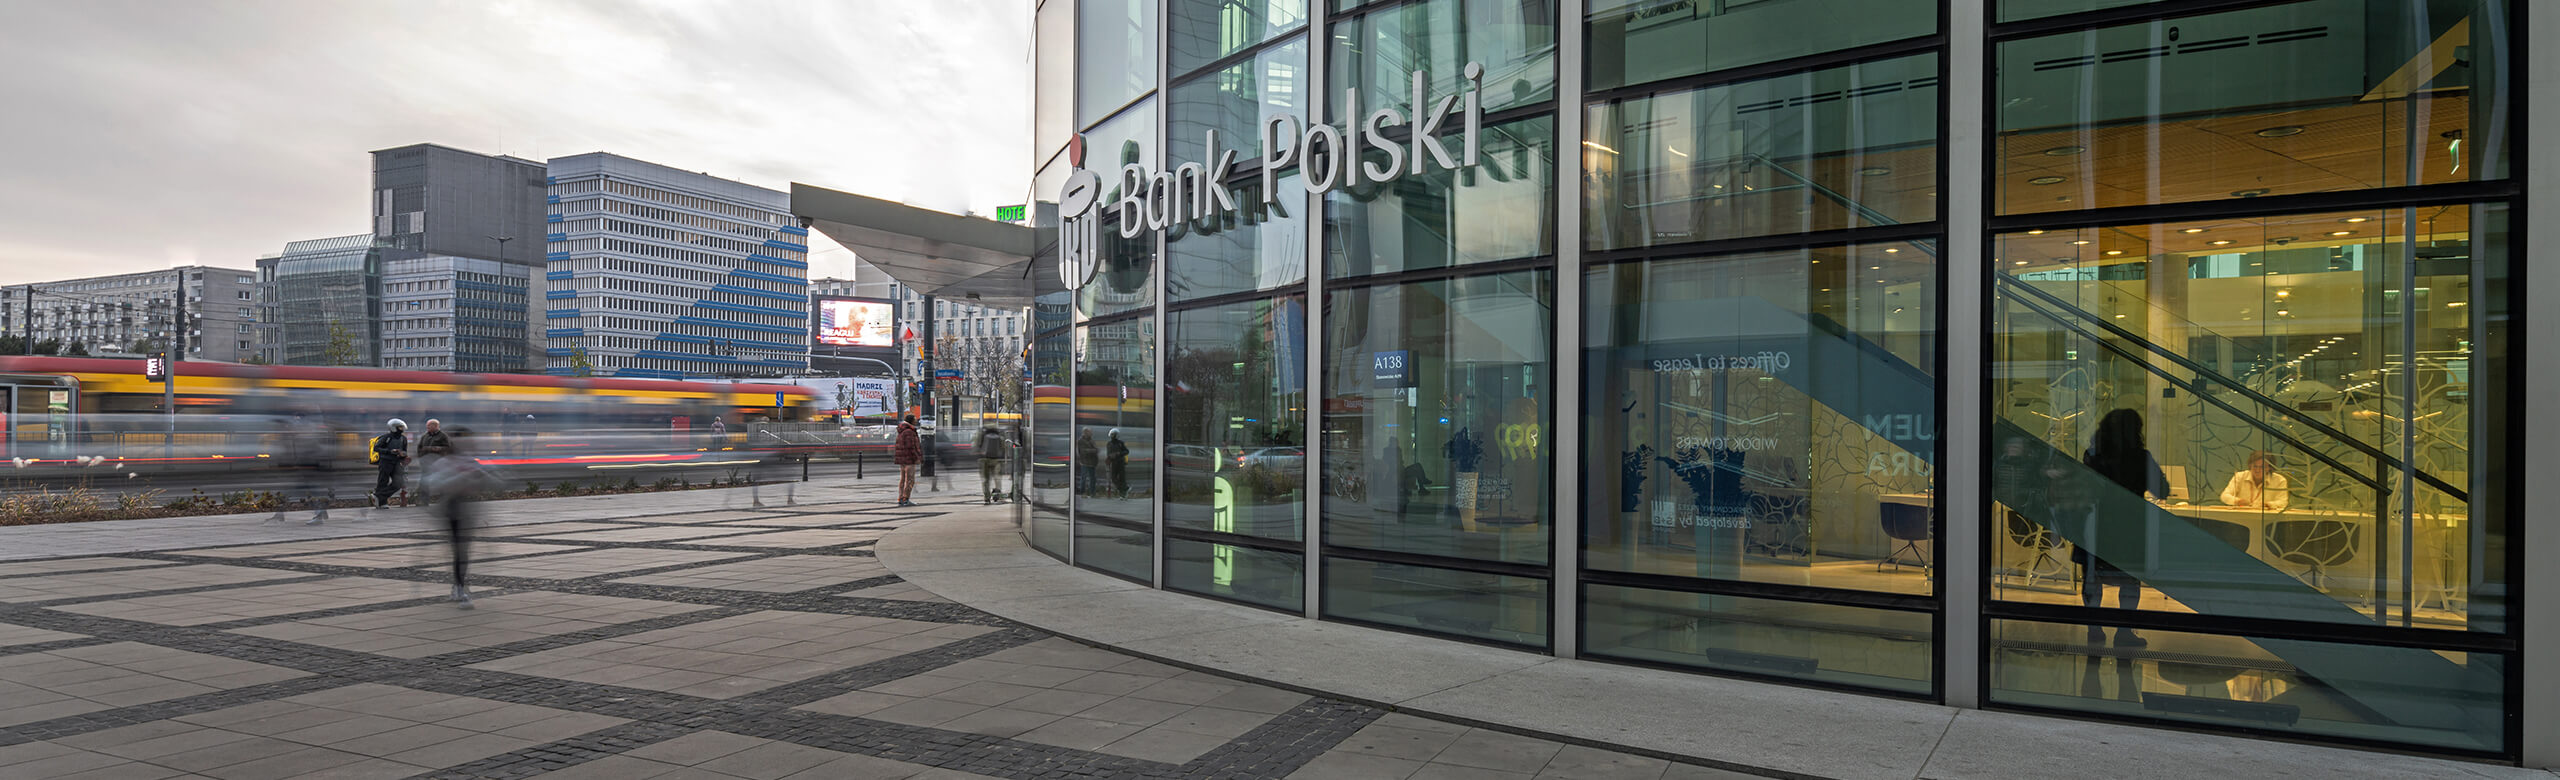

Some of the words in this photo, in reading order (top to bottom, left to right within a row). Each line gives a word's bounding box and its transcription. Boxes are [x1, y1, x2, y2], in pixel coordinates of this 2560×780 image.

[1120, 129, 1237, 239] Bank
[1263, 61, 1484, 203] Polski
[1374, 355, 1402, 369] A138
